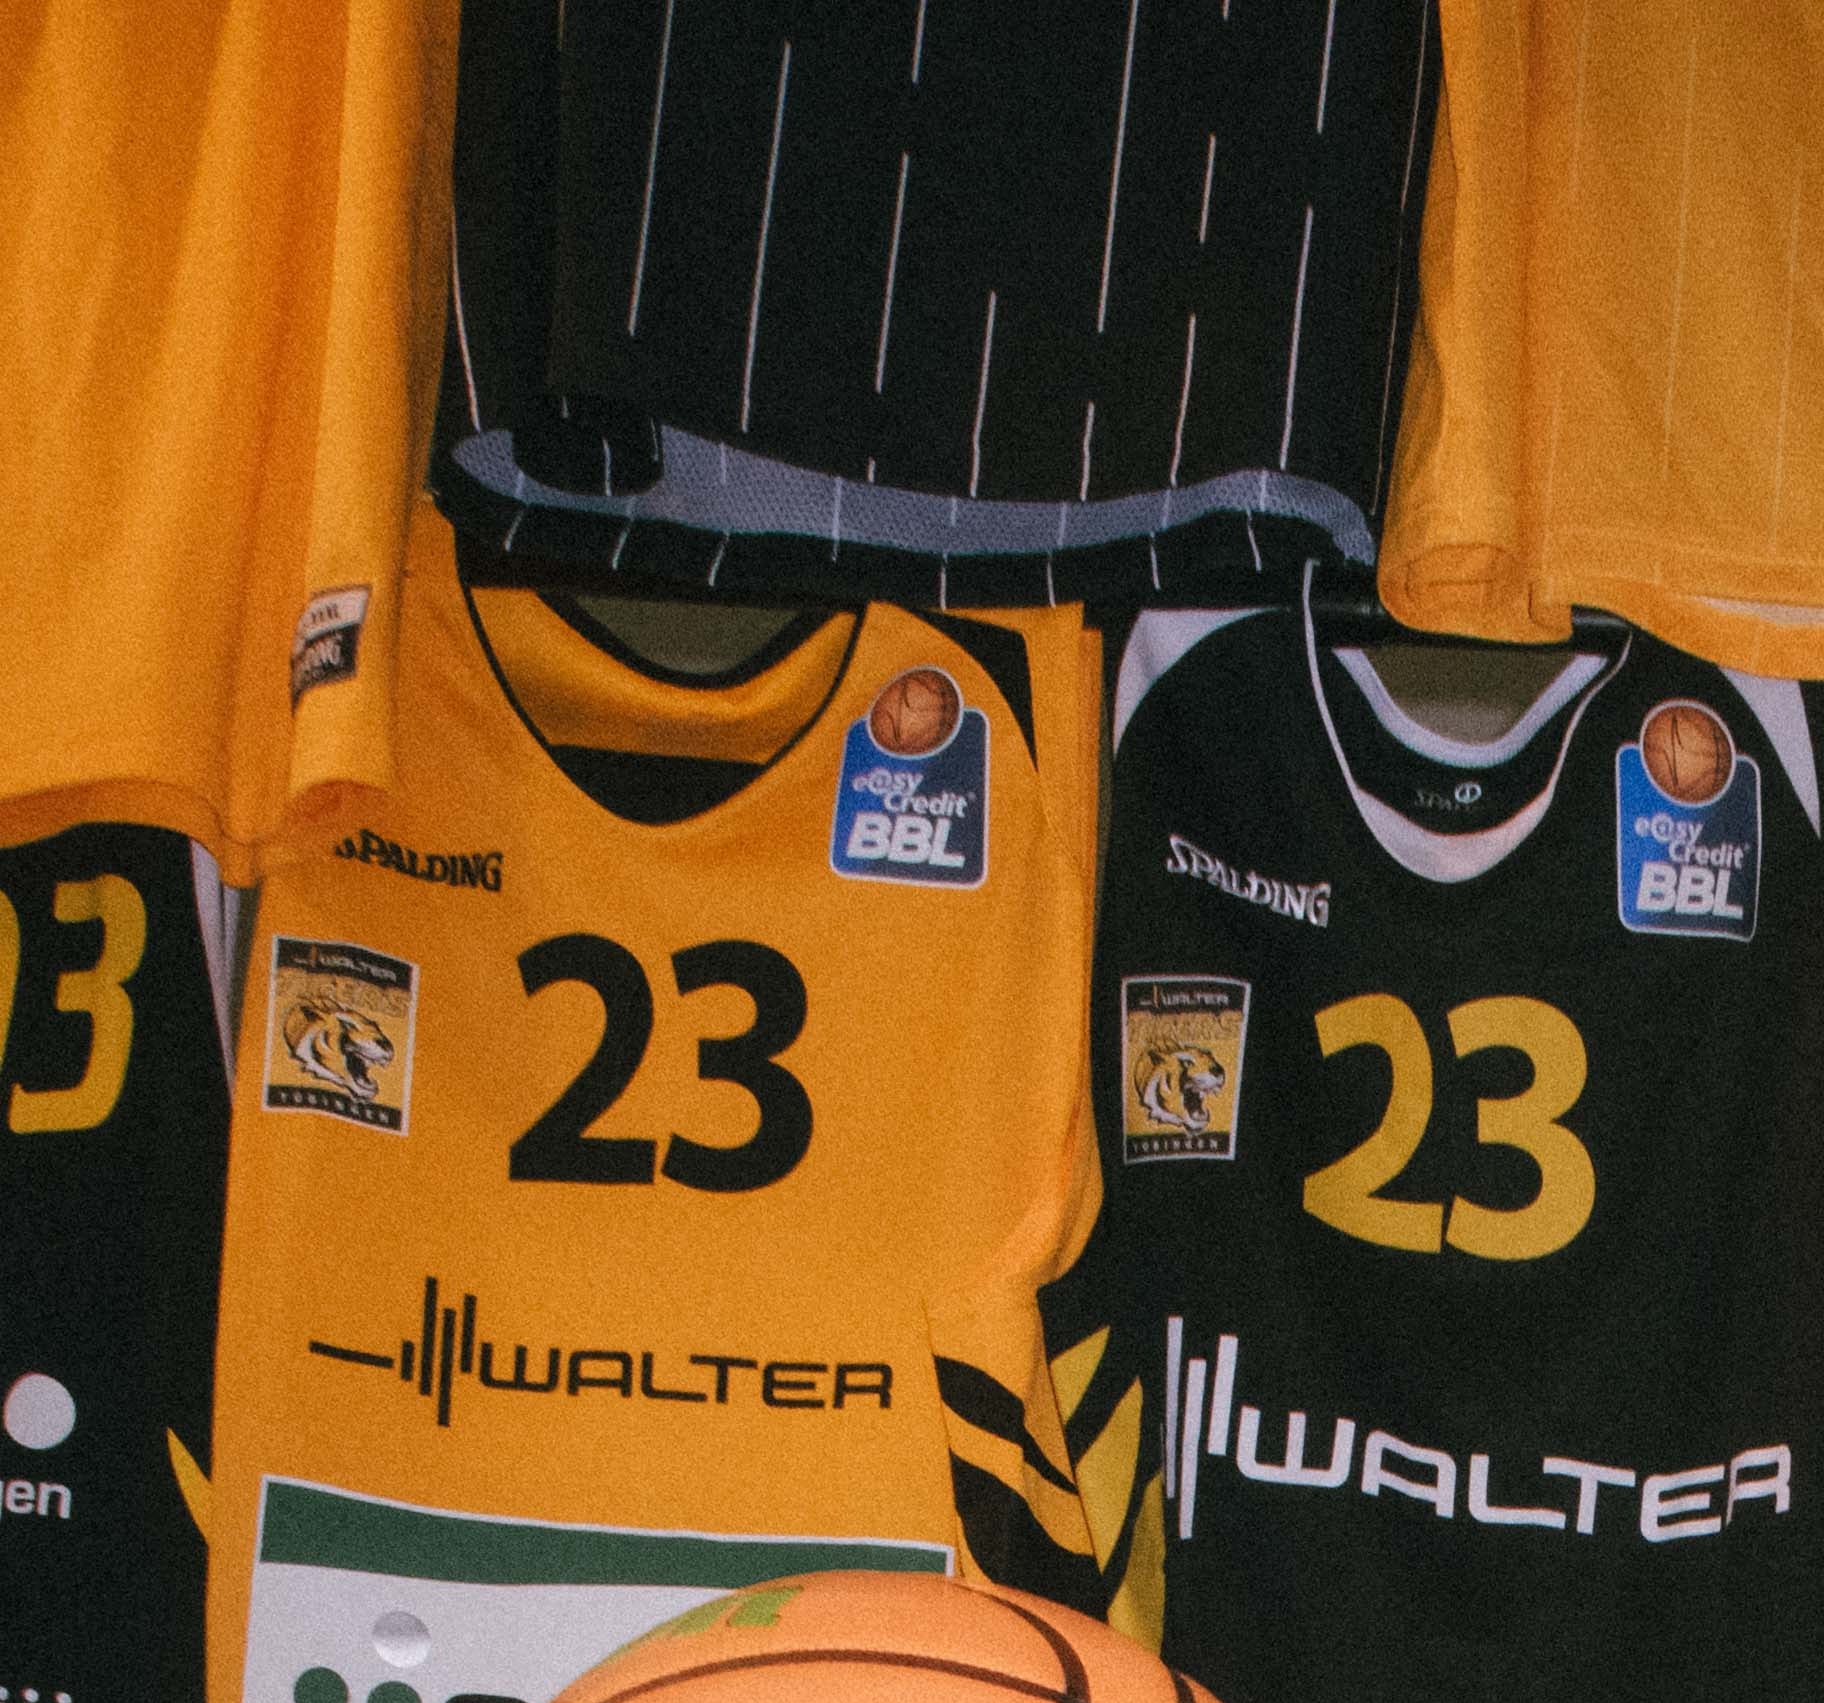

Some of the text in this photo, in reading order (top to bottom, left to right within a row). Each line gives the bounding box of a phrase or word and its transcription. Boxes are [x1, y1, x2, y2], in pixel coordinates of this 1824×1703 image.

[847, 812, 966, 868] BBL
[884, 791, 967, 818] Credit
[1167, 834, 1331, 928] SPALDING
[1636, 861, 1743, 920] BBL
[1669, 842, 1743, 869] Credit
[0, 873, 147, 1134] 3
[508, 932, 814, 1193] 23
[1303, 992, 1596, 1261] 23
[479, 1342, 892, 1409] WALTER
[1237, 1405, 1791, 1543] WALTER
